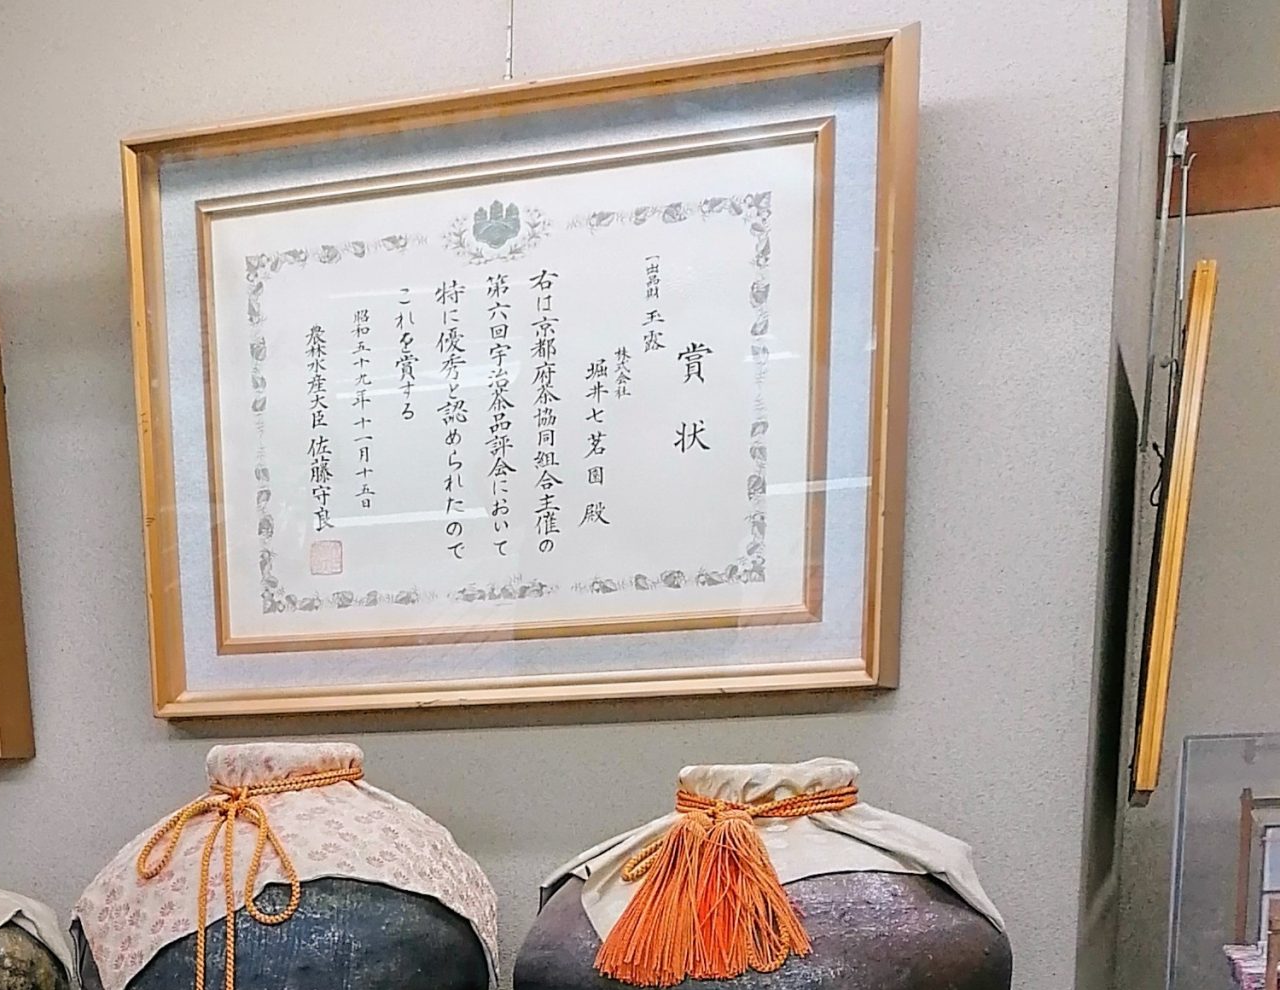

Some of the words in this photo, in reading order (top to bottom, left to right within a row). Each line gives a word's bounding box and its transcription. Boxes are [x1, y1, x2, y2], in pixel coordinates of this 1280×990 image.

[394, 288, 420, 421] これを賞する
[614, 346, 632, 400] 株式会社
[641, 309, 668, 353] 玉露
[351, 309, 376, 509] 昭和五十九年十一月十五日
[434, 280, 470, 560] 特に優秀と認められたので
[484, 273, 517, 556] 第六回宇治茶品評会において
[529, 269, 564, 554] 右は京都府茶協同組合主催の
[673, 342, 714, 454] 賞状
[578, 501, 612, 528] 殿
